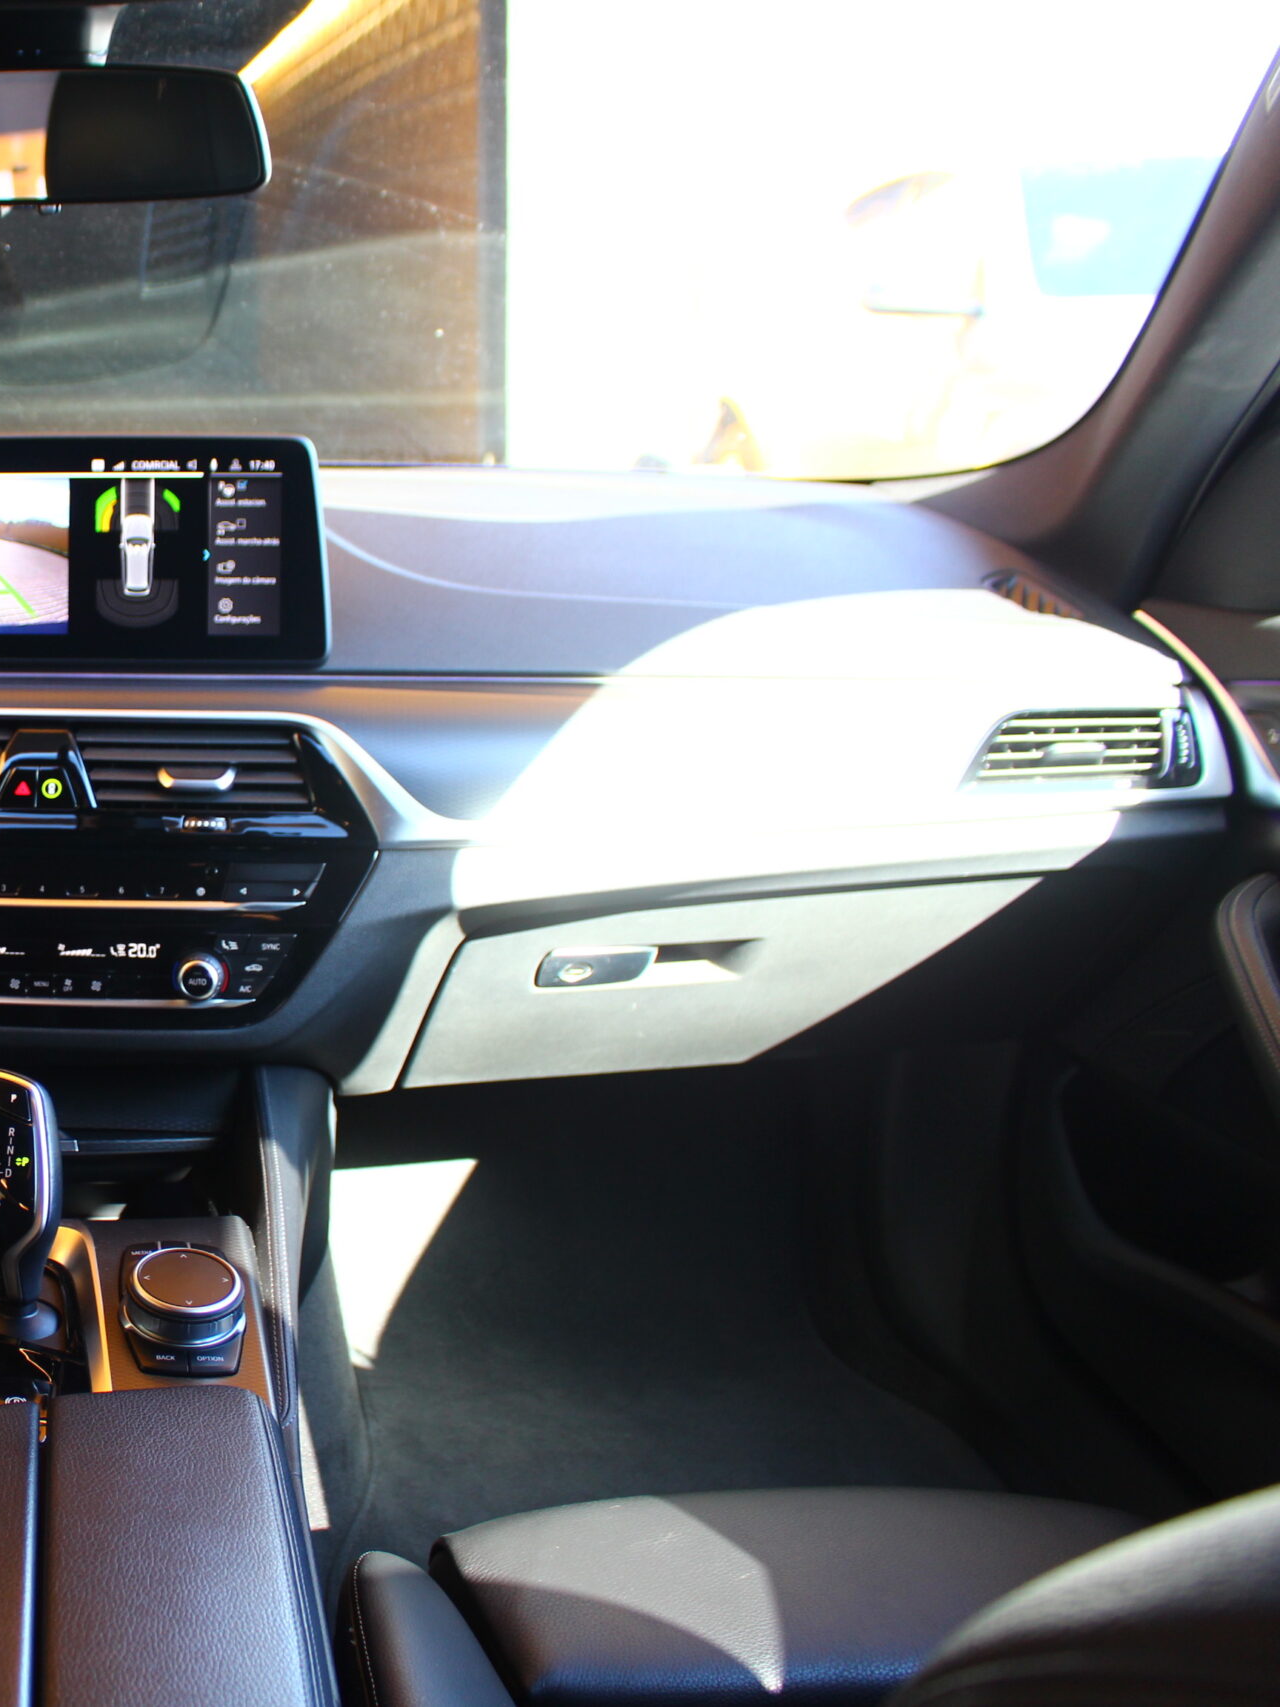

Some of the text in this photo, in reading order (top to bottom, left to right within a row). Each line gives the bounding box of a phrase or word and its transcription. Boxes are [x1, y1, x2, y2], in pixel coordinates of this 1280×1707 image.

[1, 883, 7, 892] 3
[39, 885, 45, 893] 4
[79, 885, 85, 894] 5
[159, 886, 165, 895] 7
[261, 943, 280, 951] SYNC
[188, 978, 207, 986] AUTO
[239, 985, 252, 993] A/C
[10, 1093, 18, 1103] P
[8, 1127, 15, 1137] R
[7, 1146, 14, 1155] N
[21, 1156, 30, 1167] P
[5, 1168, 12, 1177] D
